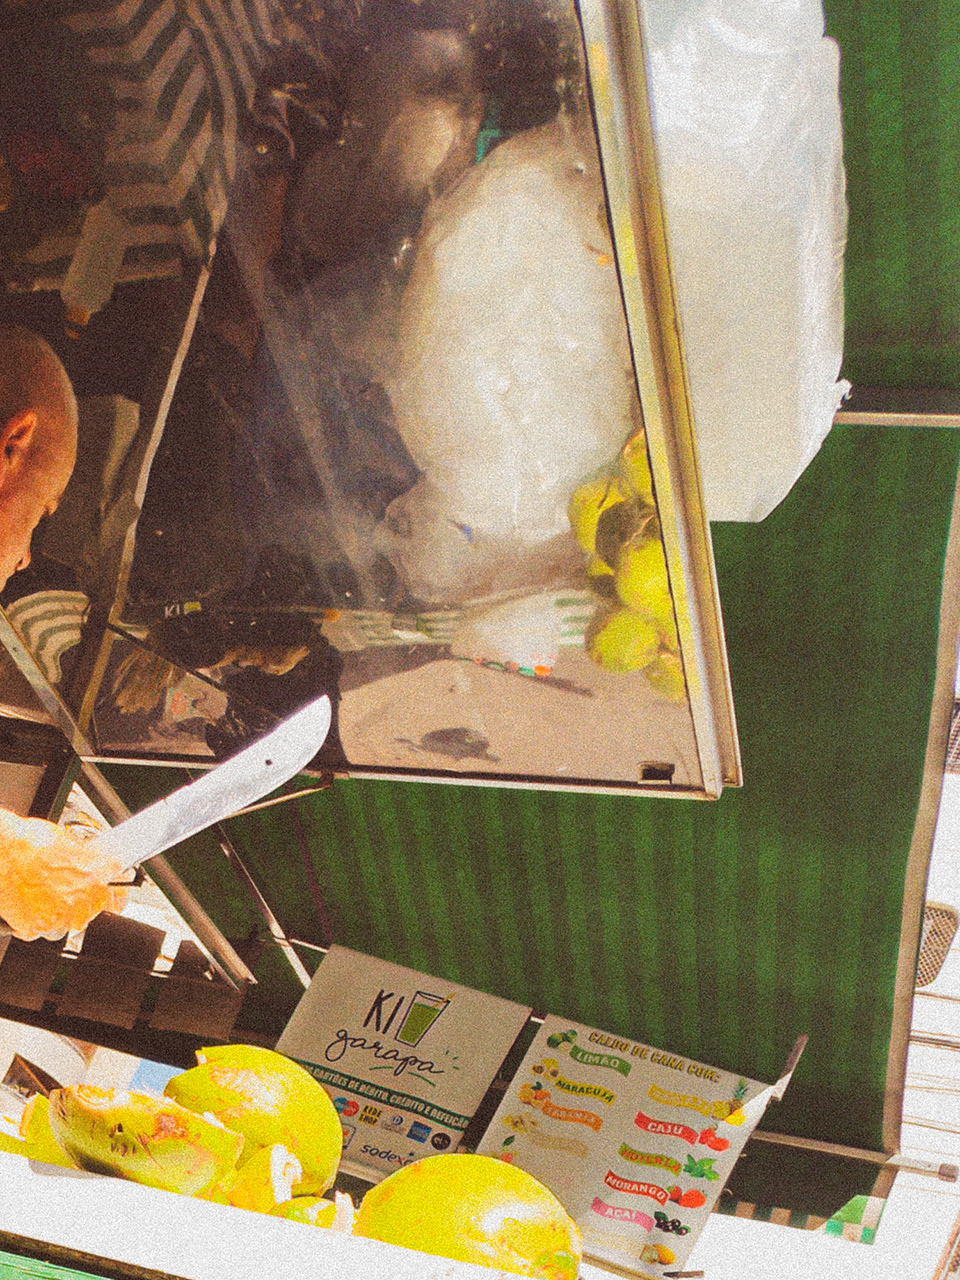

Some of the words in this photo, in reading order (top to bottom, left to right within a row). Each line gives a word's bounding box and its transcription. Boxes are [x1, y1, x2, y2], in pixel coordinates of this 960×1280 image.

[362, 988, 406, 1034] KI
[324, 1028, 445, 1076] garapa
[588, 1031, 630, 1053] CALDO
[630, 1044, 649, 1060] DE
[650, 1051, 685, 1071] CANA
[686, 1063, 721, 1084] COM:
[358, 1113, 378, 1126] SHOP
[646, 1121, 684, 1136] CAJU
[605, 1175, 667, 1201] MORANGO
